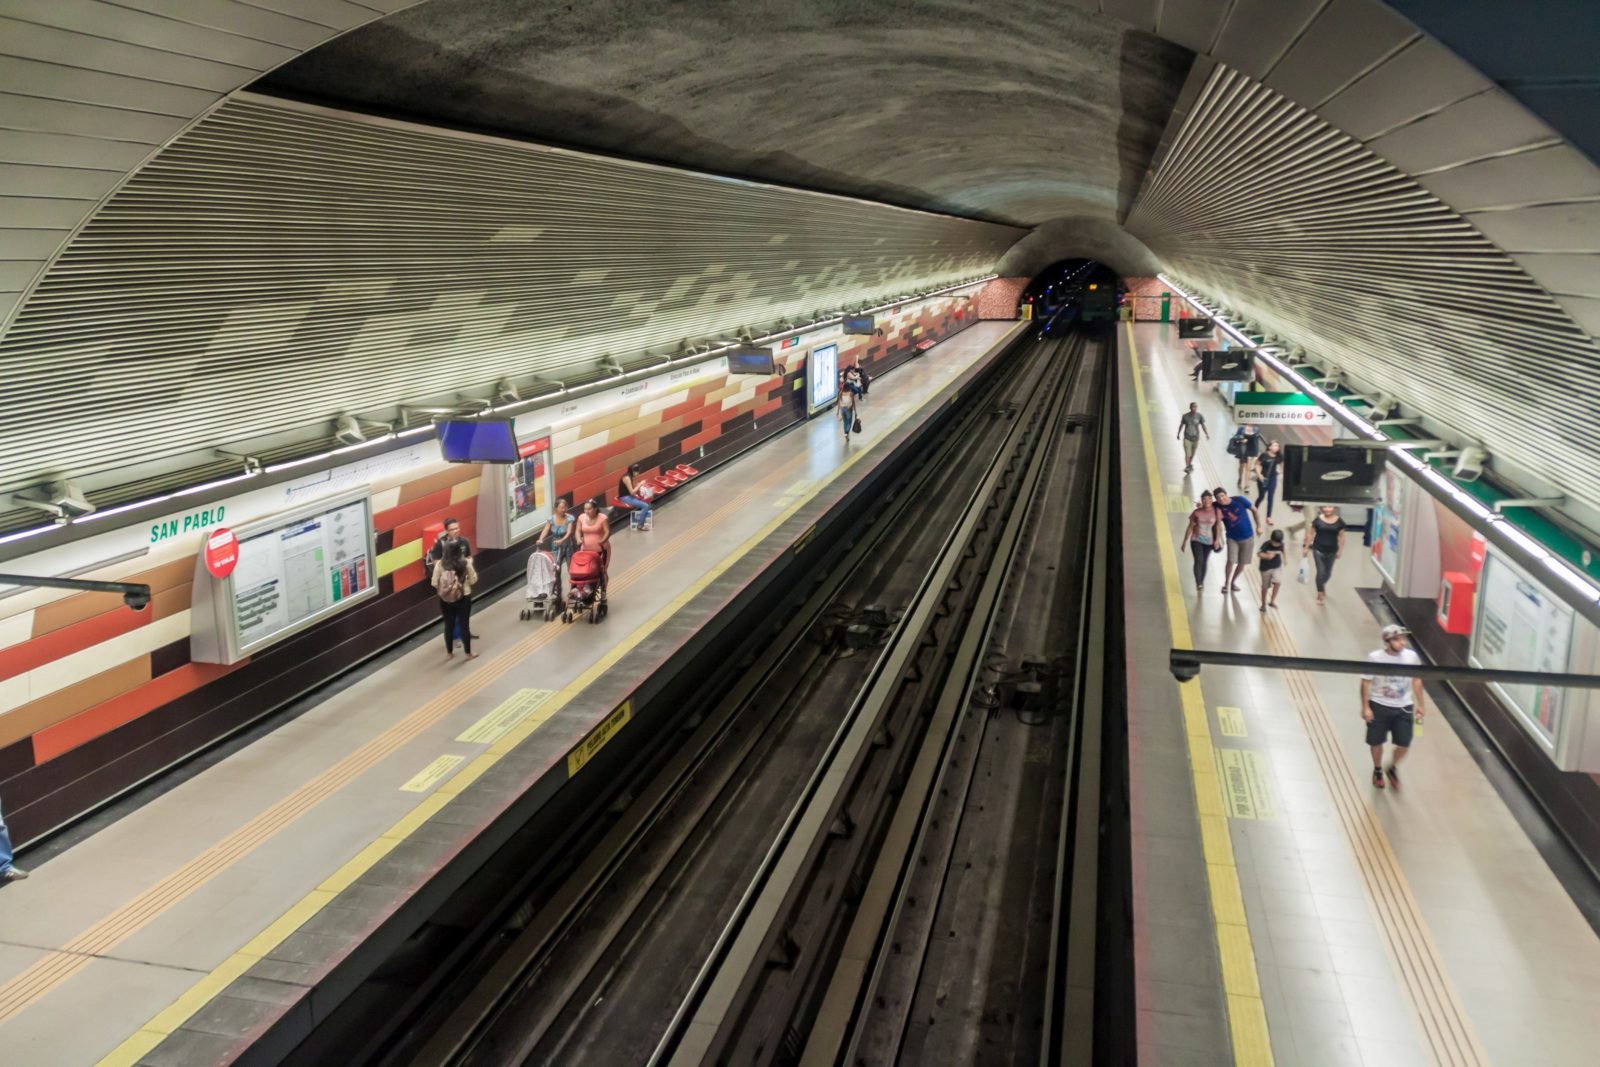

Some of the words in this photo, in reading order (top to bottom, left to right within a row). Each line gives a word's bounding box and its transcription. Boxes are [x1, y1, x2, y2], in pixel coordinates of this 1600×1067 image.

[1238, 410, 1303, 419] Combinación
[150, 519, 178, 542] SAN
[184, 505, 225, 532] PABLO
